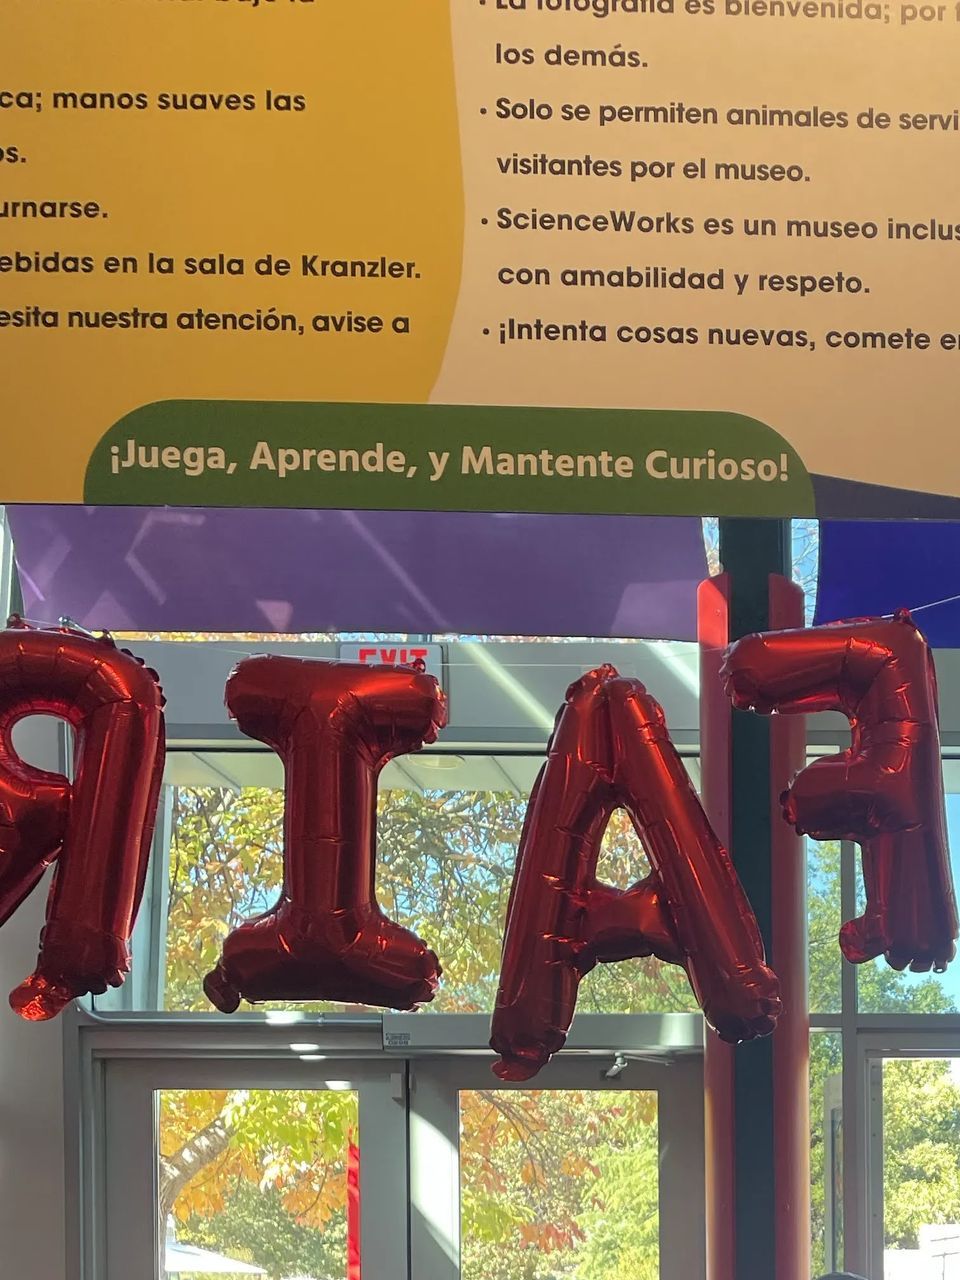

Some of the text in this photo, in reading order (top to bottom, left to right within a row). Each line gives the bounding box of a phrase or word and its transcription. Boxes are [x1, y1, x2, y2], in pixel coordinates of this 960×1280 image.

[684, 0, 715, 15] es
[725, 0, 890, 24] bienvenida;
[900, 4, 946, 25] por
[495, 42, 648, 68] los demás.
[0, 89, 306, 113] ca; manos suaves las
[495, 97, 553, 121] Solo
[560, 103, 591, 122] se
[599, 101, 718, 127] permiten
[726, 104, 849, 129] animales
[856, 107, 891, 130] de
[0, 146, 27, 164] s.
[496, 152, 811, 183] visitantes por el museo.
[496, 207, 695, 235] ScienceWorks
[703, 217, 734, 236] es
[743, 218, 777, 237] un
[786, 219, 878, 239] museo
[0, 251, 421, 279] ebidas en la sala de Kranzler.
[497, 265, 870, 297] con amabilidad y respeto.
[0, 305, 410, 336] esita nuestra atención, avise a
[499, 317, 607, 345] ¡Intenta
[616, 325, 699, 345] cosas
[708, 327, 816, 352] nuevas,
[825, 327, 931, 350] comete
[110, 439, 788, 482] ¡Juega, Aprende, y Mantente Curioso!
